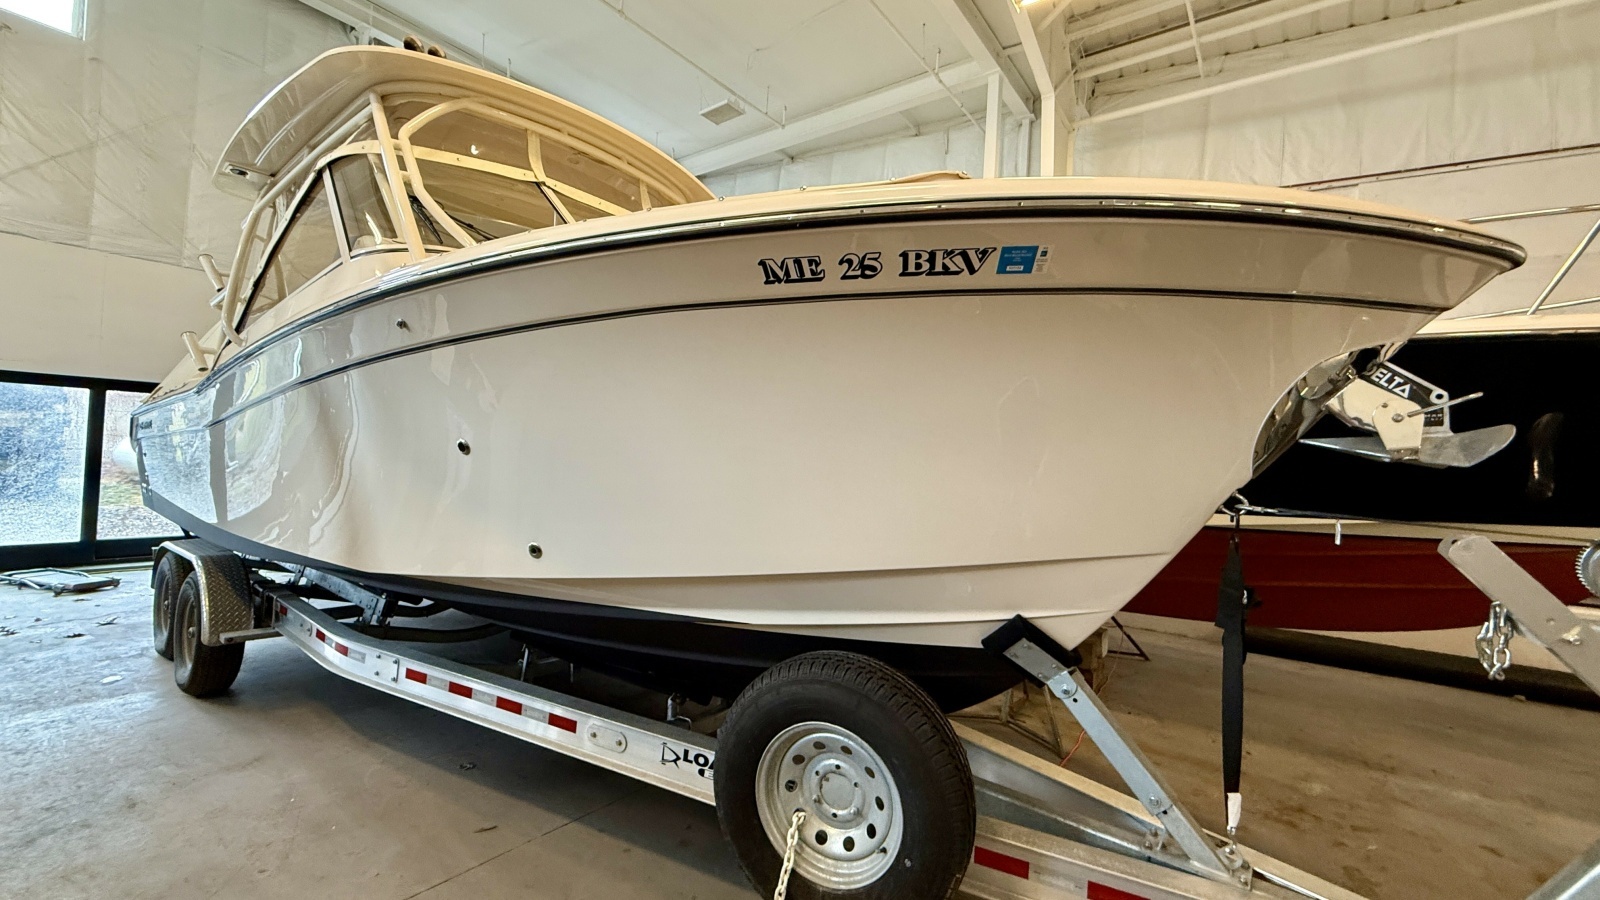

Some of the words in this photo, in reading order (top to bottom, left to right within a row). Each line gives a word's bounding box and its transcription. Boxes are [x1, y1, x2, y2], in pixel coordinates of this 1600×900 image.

[758, 256, 825, 284] ME
[839, 252, 882, 279] 25
[899, 247, 997, 277] BKV
[1370, 367, 1411, 399] ELTA
